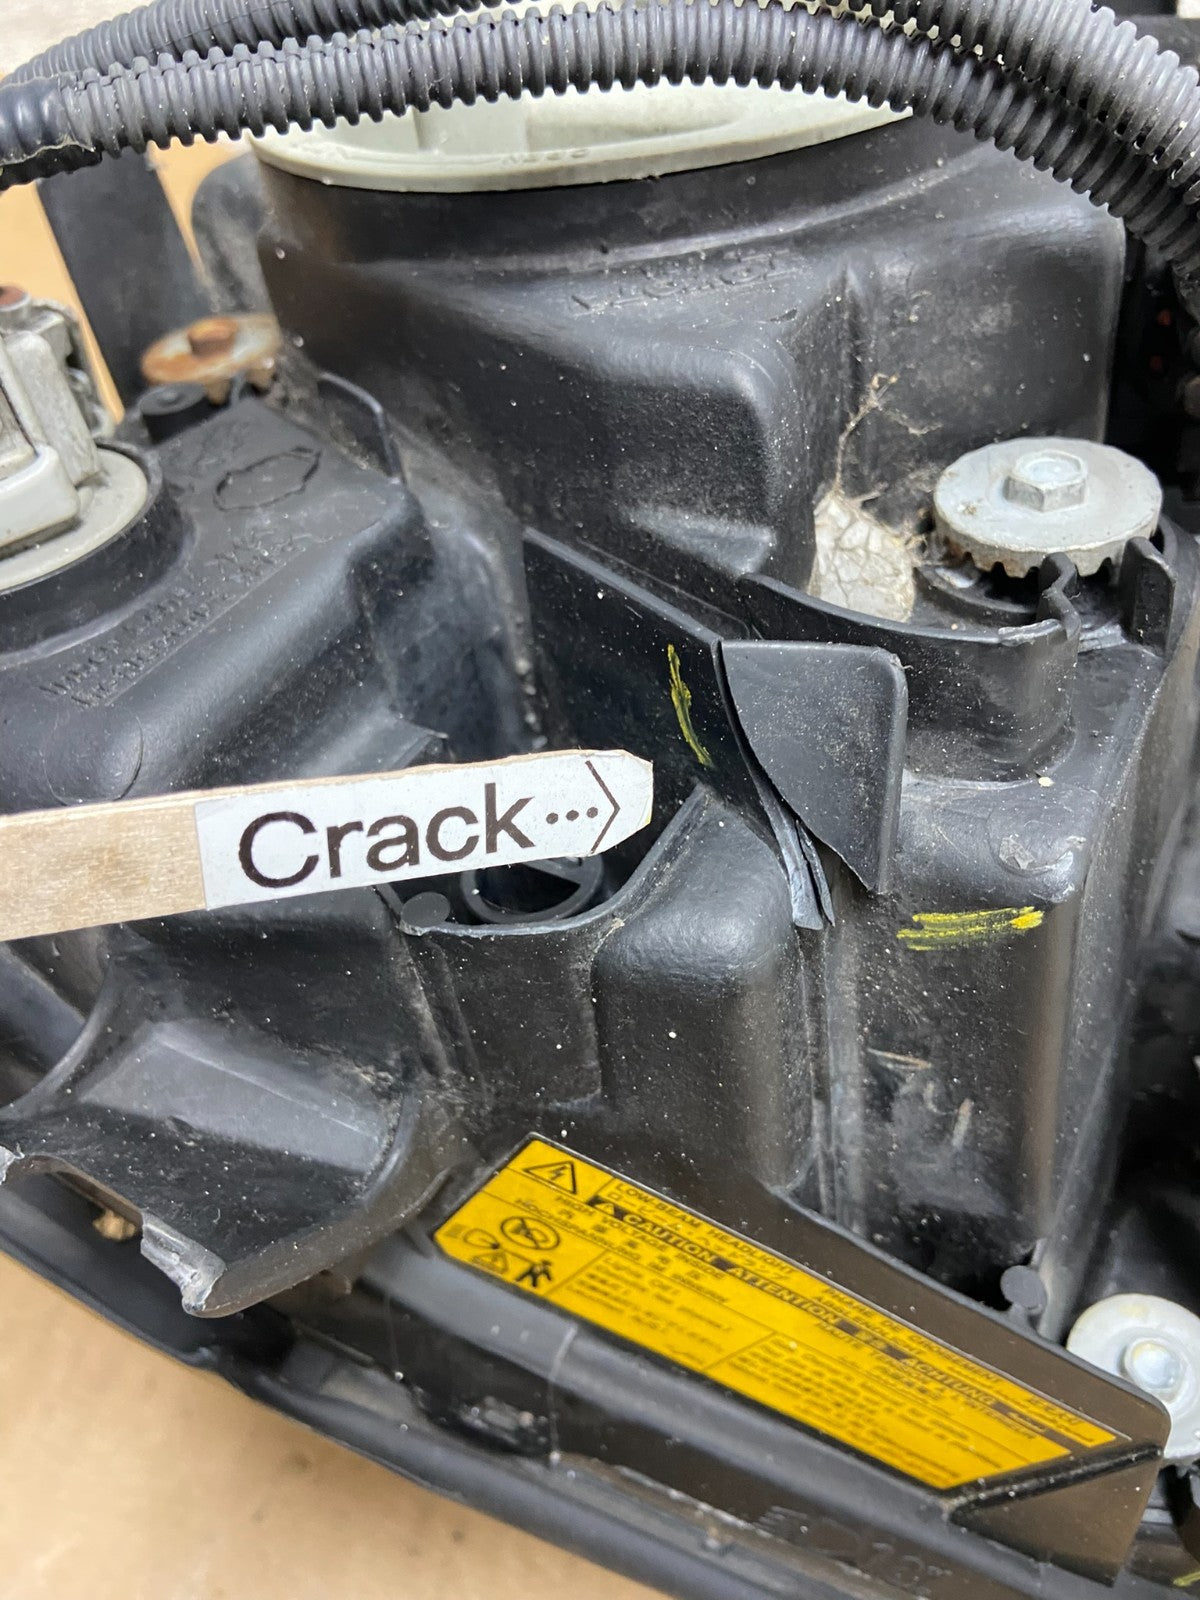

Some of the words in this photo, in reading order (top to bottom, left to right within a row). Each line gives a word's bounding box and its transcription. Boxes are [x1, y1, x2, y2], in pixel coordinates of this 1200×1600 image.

[238, 782, 535, 889] Crack
[554, 1194, 597, 1217] HIGH
[599, 1215, 670, 1252] VOLTAGE
[673, 1252, 727, 1280] INSIDE
[621, 1212, 719, 1263] CAUTION
[706, 1228, 796, 1275] HEADLIGHT
[725, 1264, 843, 1324] ATTENTION
[898, 1355, 1000, 1406] ACHTUNG
